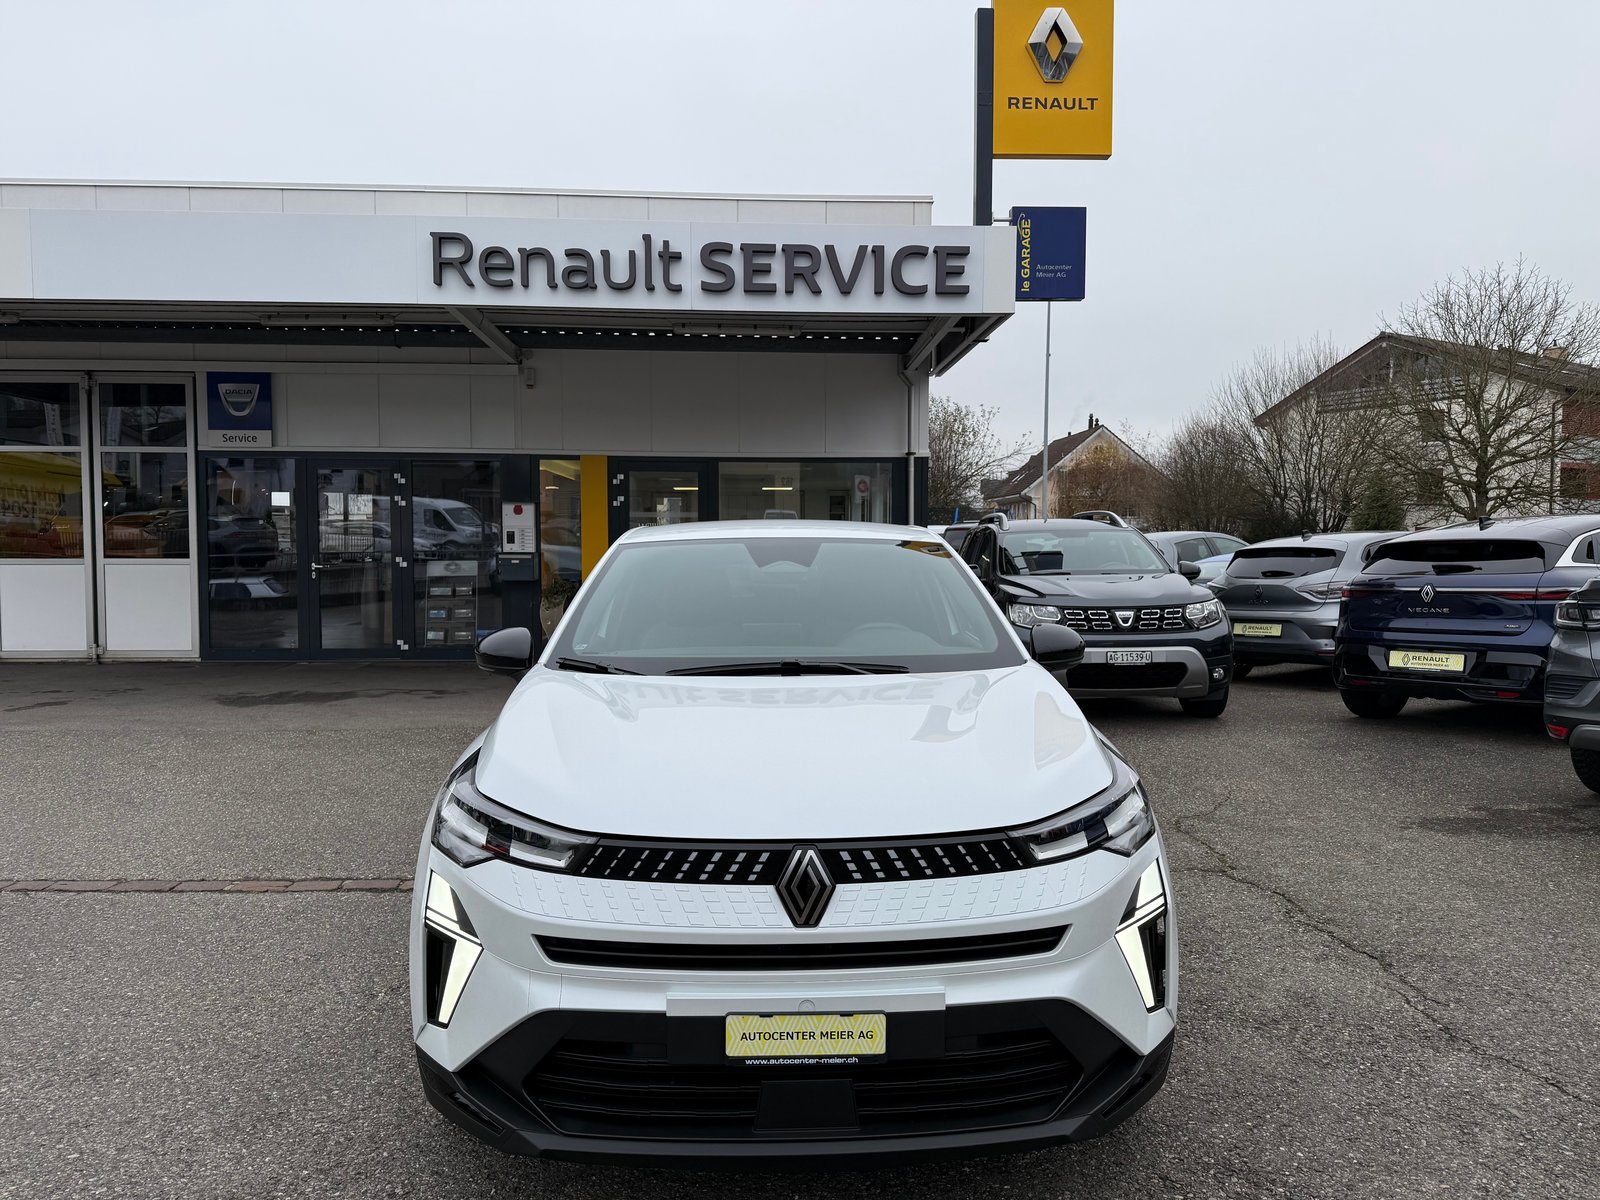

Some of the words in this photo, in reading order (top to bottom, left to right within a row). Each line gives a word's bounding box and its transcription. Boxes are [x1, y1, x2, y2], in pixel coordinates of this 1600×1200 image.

[1007, 96, 1099, 110] RENAULT
[1020, 218, 1031, 278] GARAGE
[429, 231, 683, 292] Renault
[700, 241, 971, 296] SERVICE
[1020, 281, 1030, 292] le
[222, 433, 258, 443] Service
[1411, 655, 1450, 663] RENAULT
[740, 1031, 817, 1041] AUTOCENTER
[819, 1031, 855, 1040] MEIER
[857, 1030, 874, 1040] AG
[745, 1056, 859, 1065] www.autocenter-meier.ch
